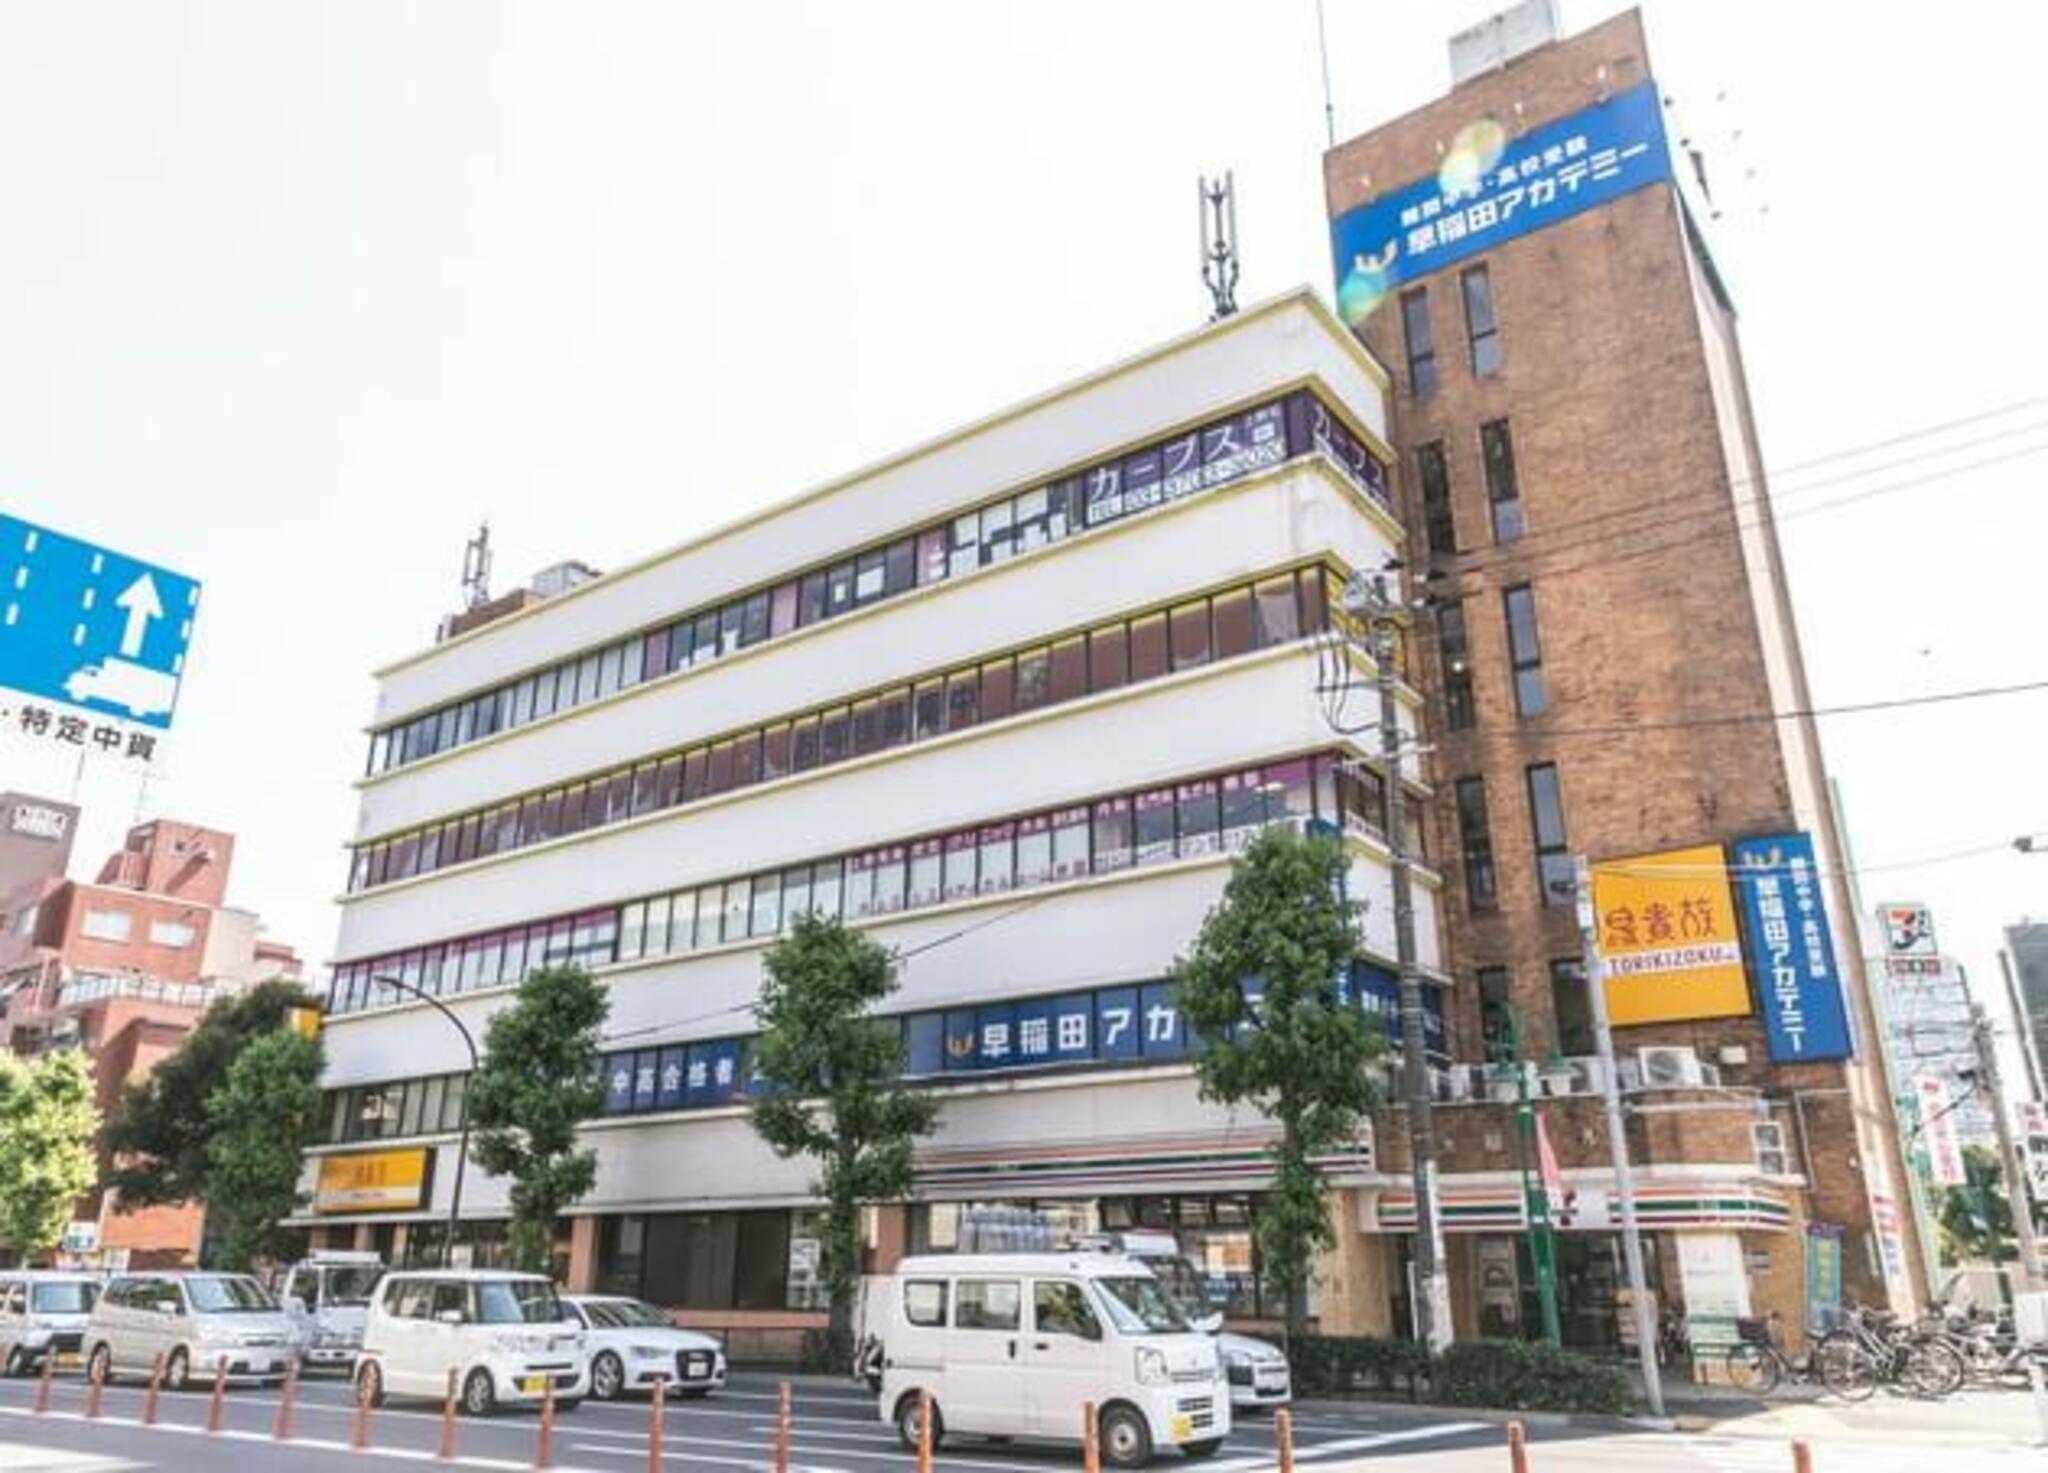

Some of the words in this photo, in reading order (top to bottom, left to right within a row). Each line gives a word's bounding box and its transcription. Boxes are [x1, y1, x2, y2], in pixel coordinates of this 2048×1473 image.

[1406, 142, 1649, 255] 早稲田アカデミー
